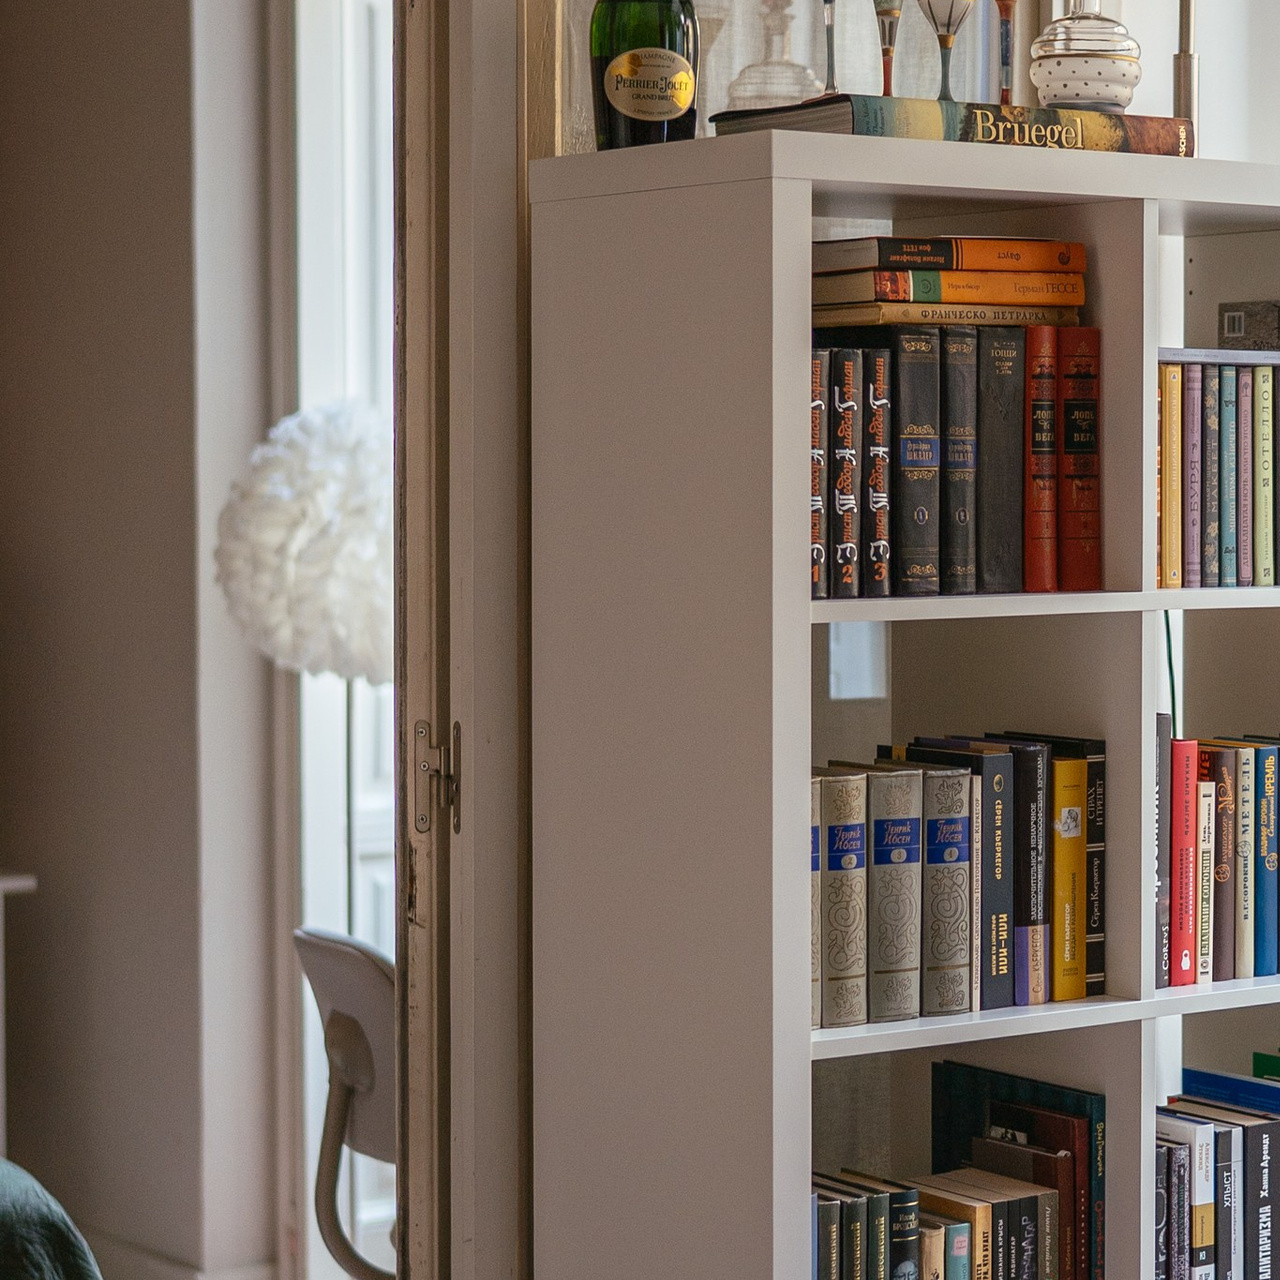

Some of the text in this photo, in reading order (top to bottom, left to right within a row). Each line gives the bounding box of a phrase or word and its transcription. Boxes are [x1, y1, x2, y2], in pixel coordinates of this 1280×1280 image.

[973, 109, 1085, 149] Bruegel
[996, 251, 1021, 263] Фауст
[1045, 279, 1080, 294] ГЕССЕ
[920, 309, 1048, 321] ФРАНЧЕСКО ПЕТРАРКА
[1261, 389, 1270, 471] ОТЕЛЛО
[1190, 459, 1200, 513] БУРЯ
[1211, 439, 1219, 514] МАКБЕТ
[841, 564, 854, 584] 2
[873, 562, 887, 580] 3
[1265, 755, 1275, 796] КРЕМЛЬ
[1087, 786, 1096, 820] СТРАХ
[1096, 778, 1104, 816] ТРЕПЕТ
[1241, 757, 1251, 836] МЕТЕЛЬ
[994, 829, 1003, 880] КЬЕРКЕГОР
[1030, 802, 1038, 921] ЗАКЛЮЧИТЕЛЬНОЕ НЕНАУЧНОЕ
[1201, 852, 1210, 955] ВЛАДИМИР СОРОКИН
[1260, 1133, 1270, 1167] Арендт
[1223, 1170, 1232, 1207] ХЛЫСТ
[1259, 1168, 1270, 1198] Ханна
